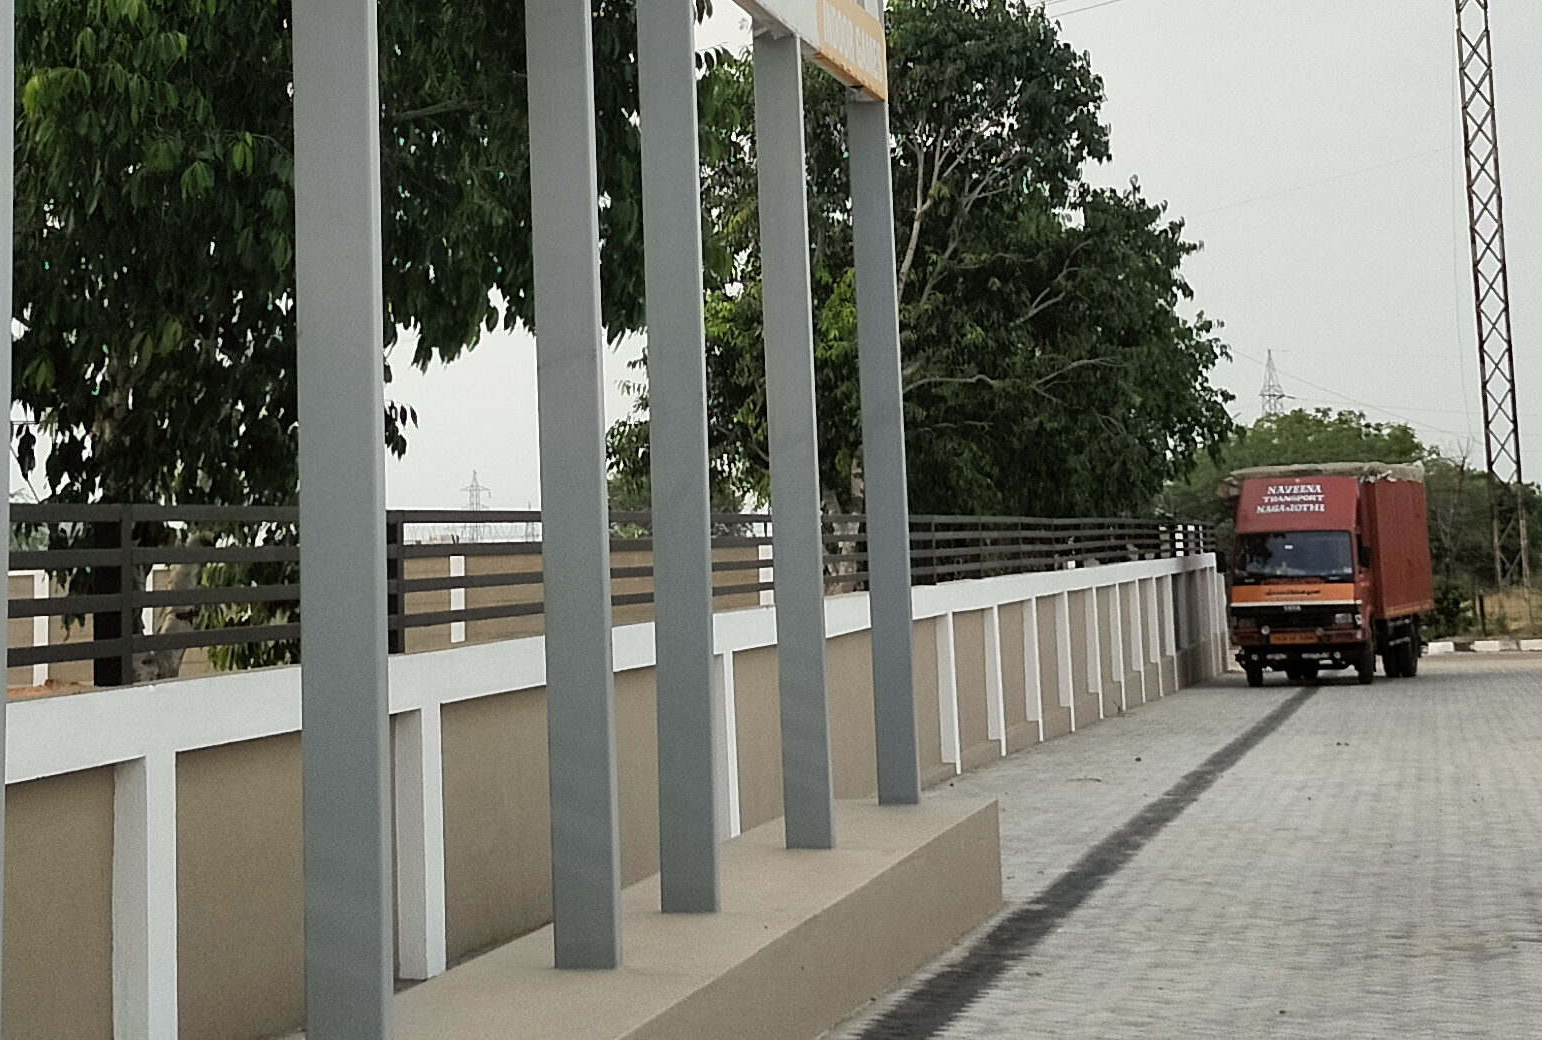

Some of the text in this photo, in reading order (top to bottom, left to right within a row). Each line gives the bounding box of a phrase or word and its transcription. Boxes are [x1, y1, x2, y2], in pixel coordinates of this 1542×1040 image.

[823, 0, 883, 83] INDOOR GAMES
[1262, 494, 1325, 503] TRANSPORT
